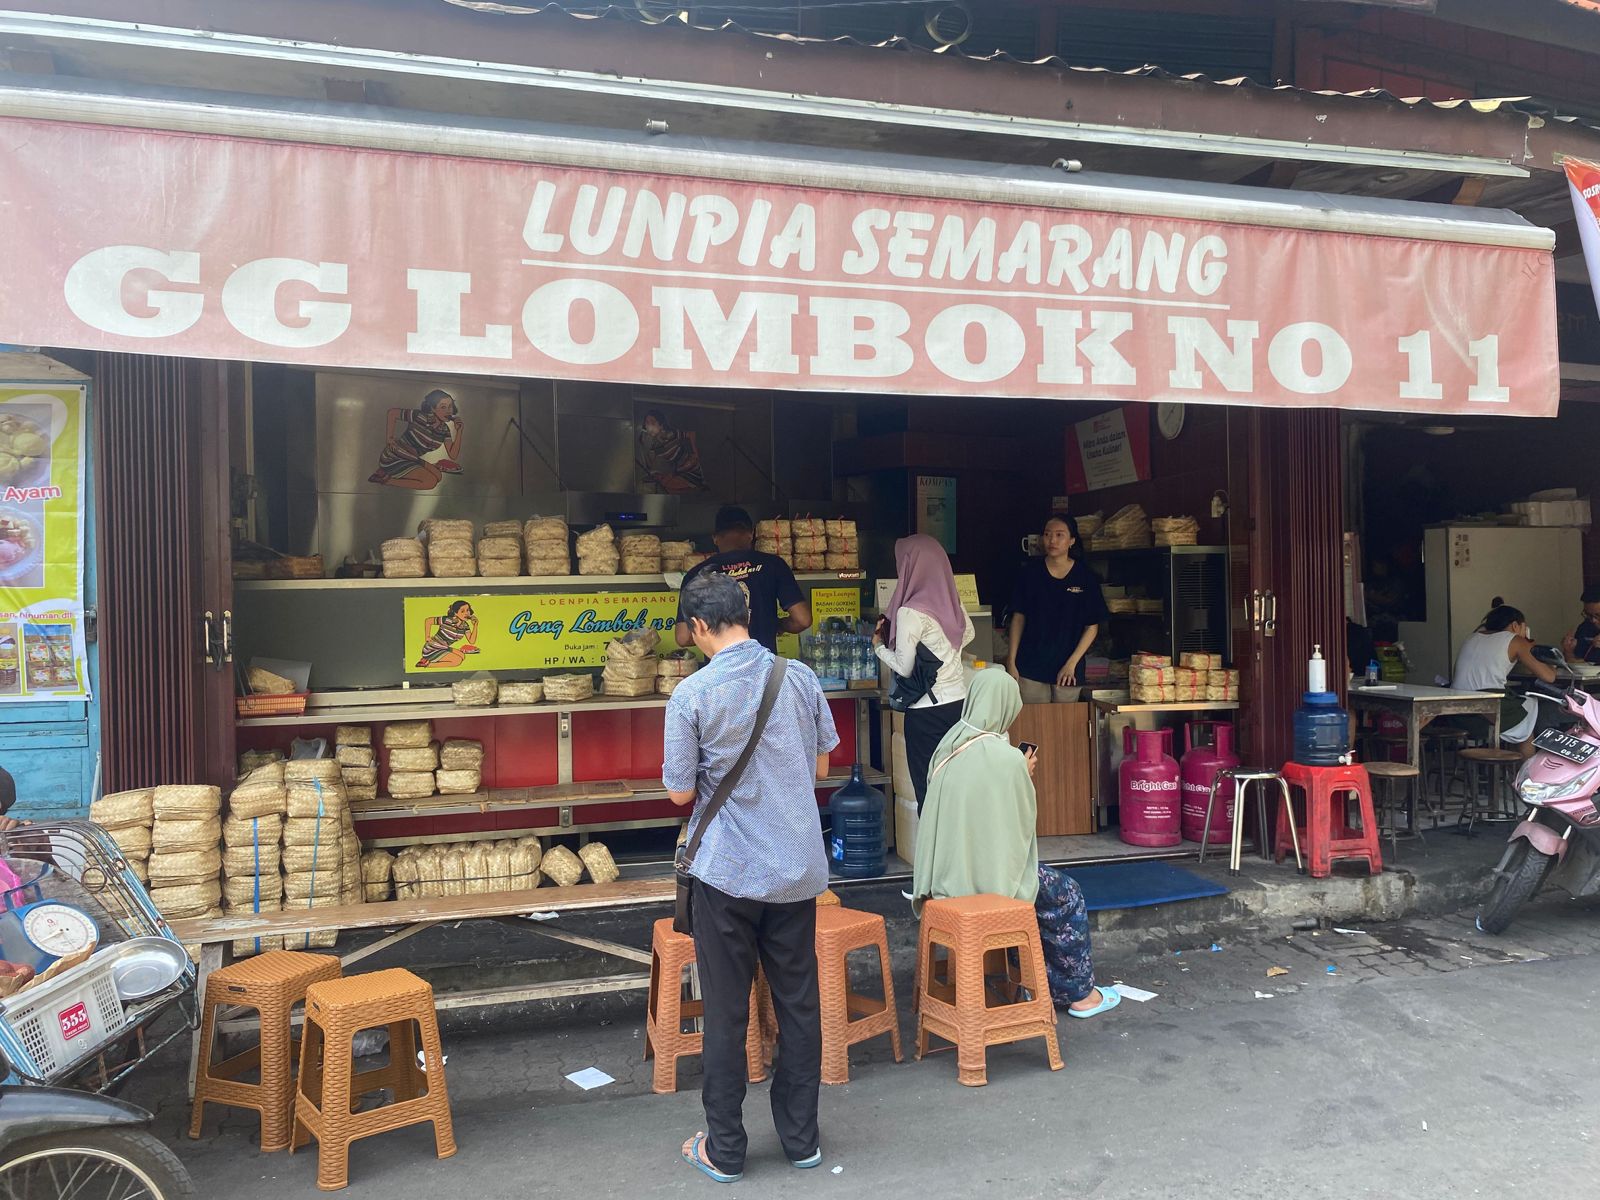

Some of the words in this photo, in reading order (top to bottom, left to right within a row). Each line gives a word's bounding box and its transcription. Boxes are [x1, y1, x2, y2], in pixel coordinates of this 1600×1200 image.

[1583, 184, 1600, 199] SOSR
[522, 180, 815, 272] LUNPIA
[841, 208, 1228, 297] SEMARANG
[64, 245, 352, 349] GG
[407, 268, 1137, 386] LOMBOK
[1167, 315, 1353, 394] NO
[1398, 329, 1510, 403] 11
[4, 486, 61, 503] Ayam
[540, 598, 599, 606] LOENPIA
[604, 596, 676, 605] SEMARANG
[509, 610, 564, 641] Gang
[568, 608, 648, 633] Lombok
[544, 657, 559, 665] HP
[569, 656, 586, 664] WA
[1543, 730, 1553, 739] H
[1554, 734, 1579, 748] 3115
[1580, 744, 1595, 755] RA
[1130, 780, 1161, 792] Bright
[62, 1009, 87, 1031] 555
